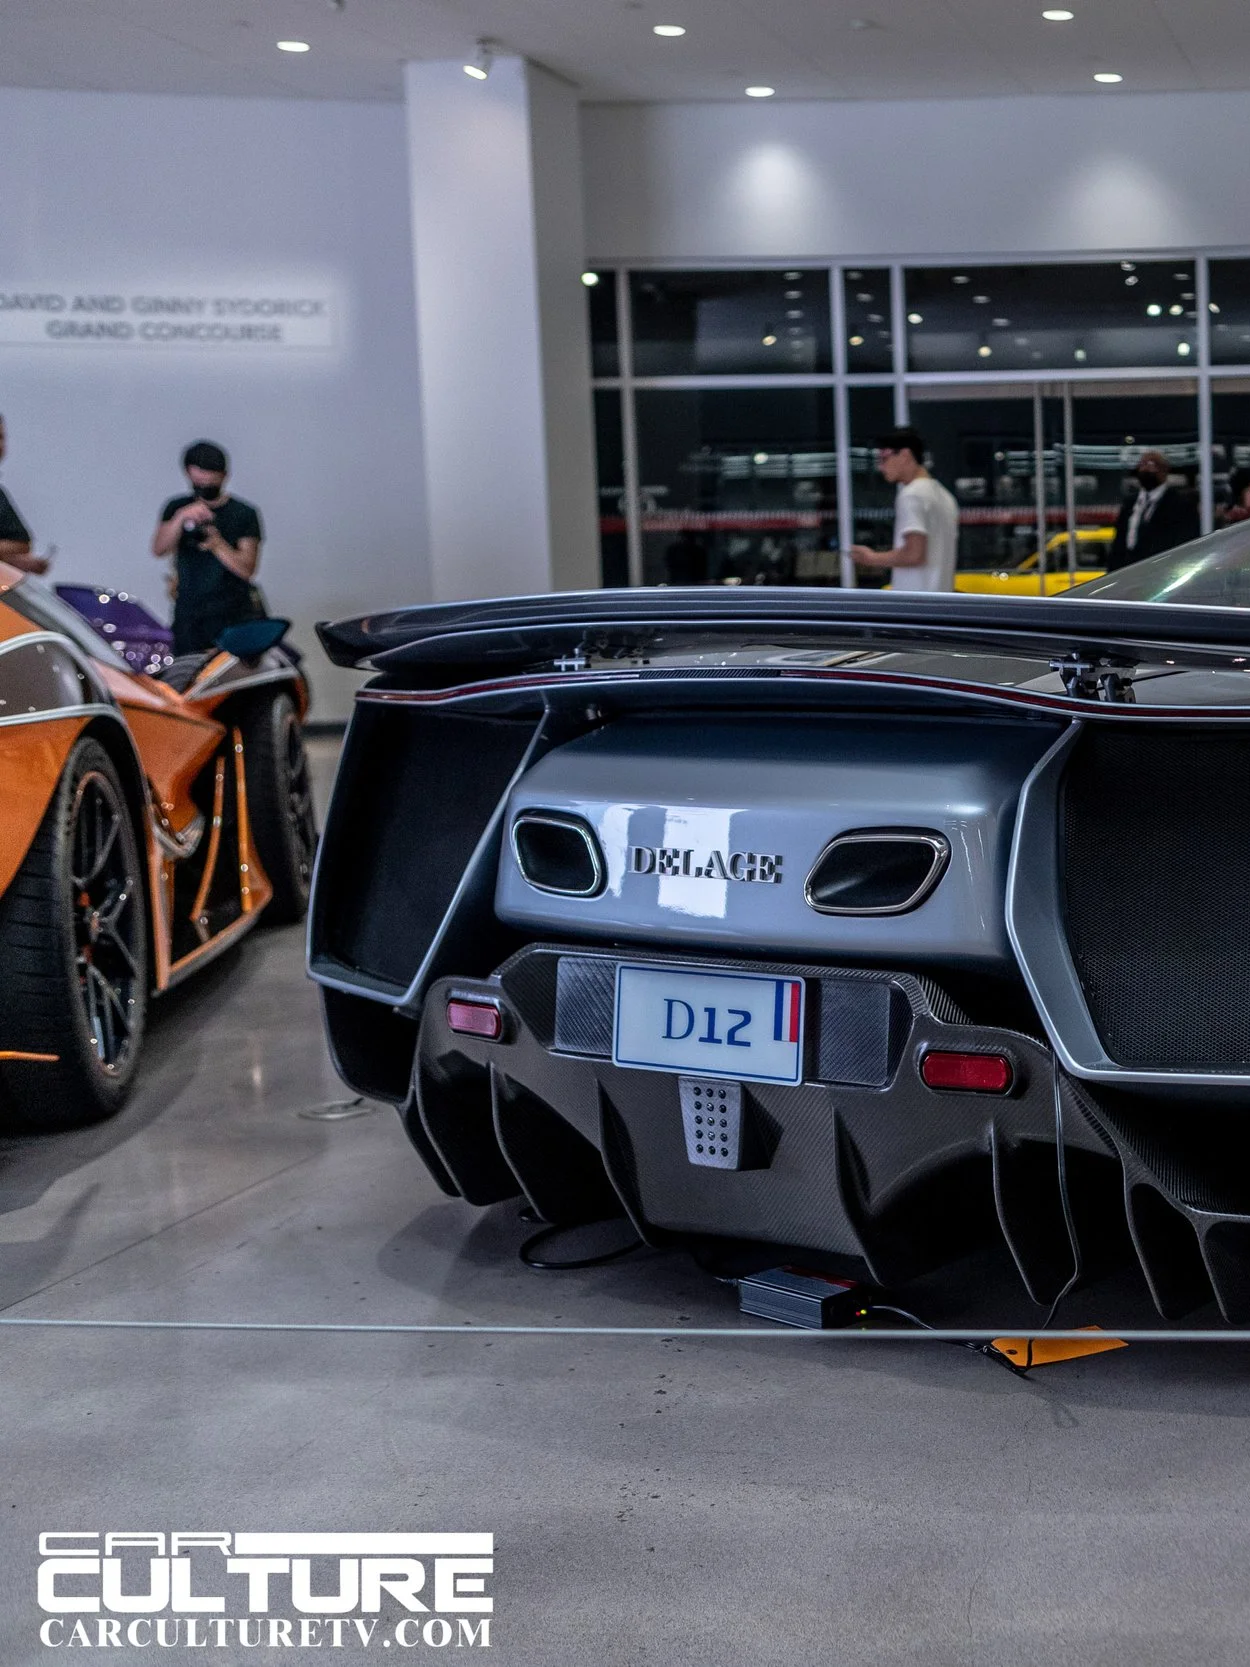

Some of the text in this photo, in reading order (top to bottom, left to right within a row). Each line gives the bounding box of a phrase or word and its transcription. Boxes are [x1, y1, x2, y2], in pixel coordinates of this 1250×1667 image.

[70, 294, 127, 313] AND
[45, 319, 283, 342] GRAND CONCOURSE
[629, 845, 784, 884] DELAGE
[661, 998, 753, 1048] D12
